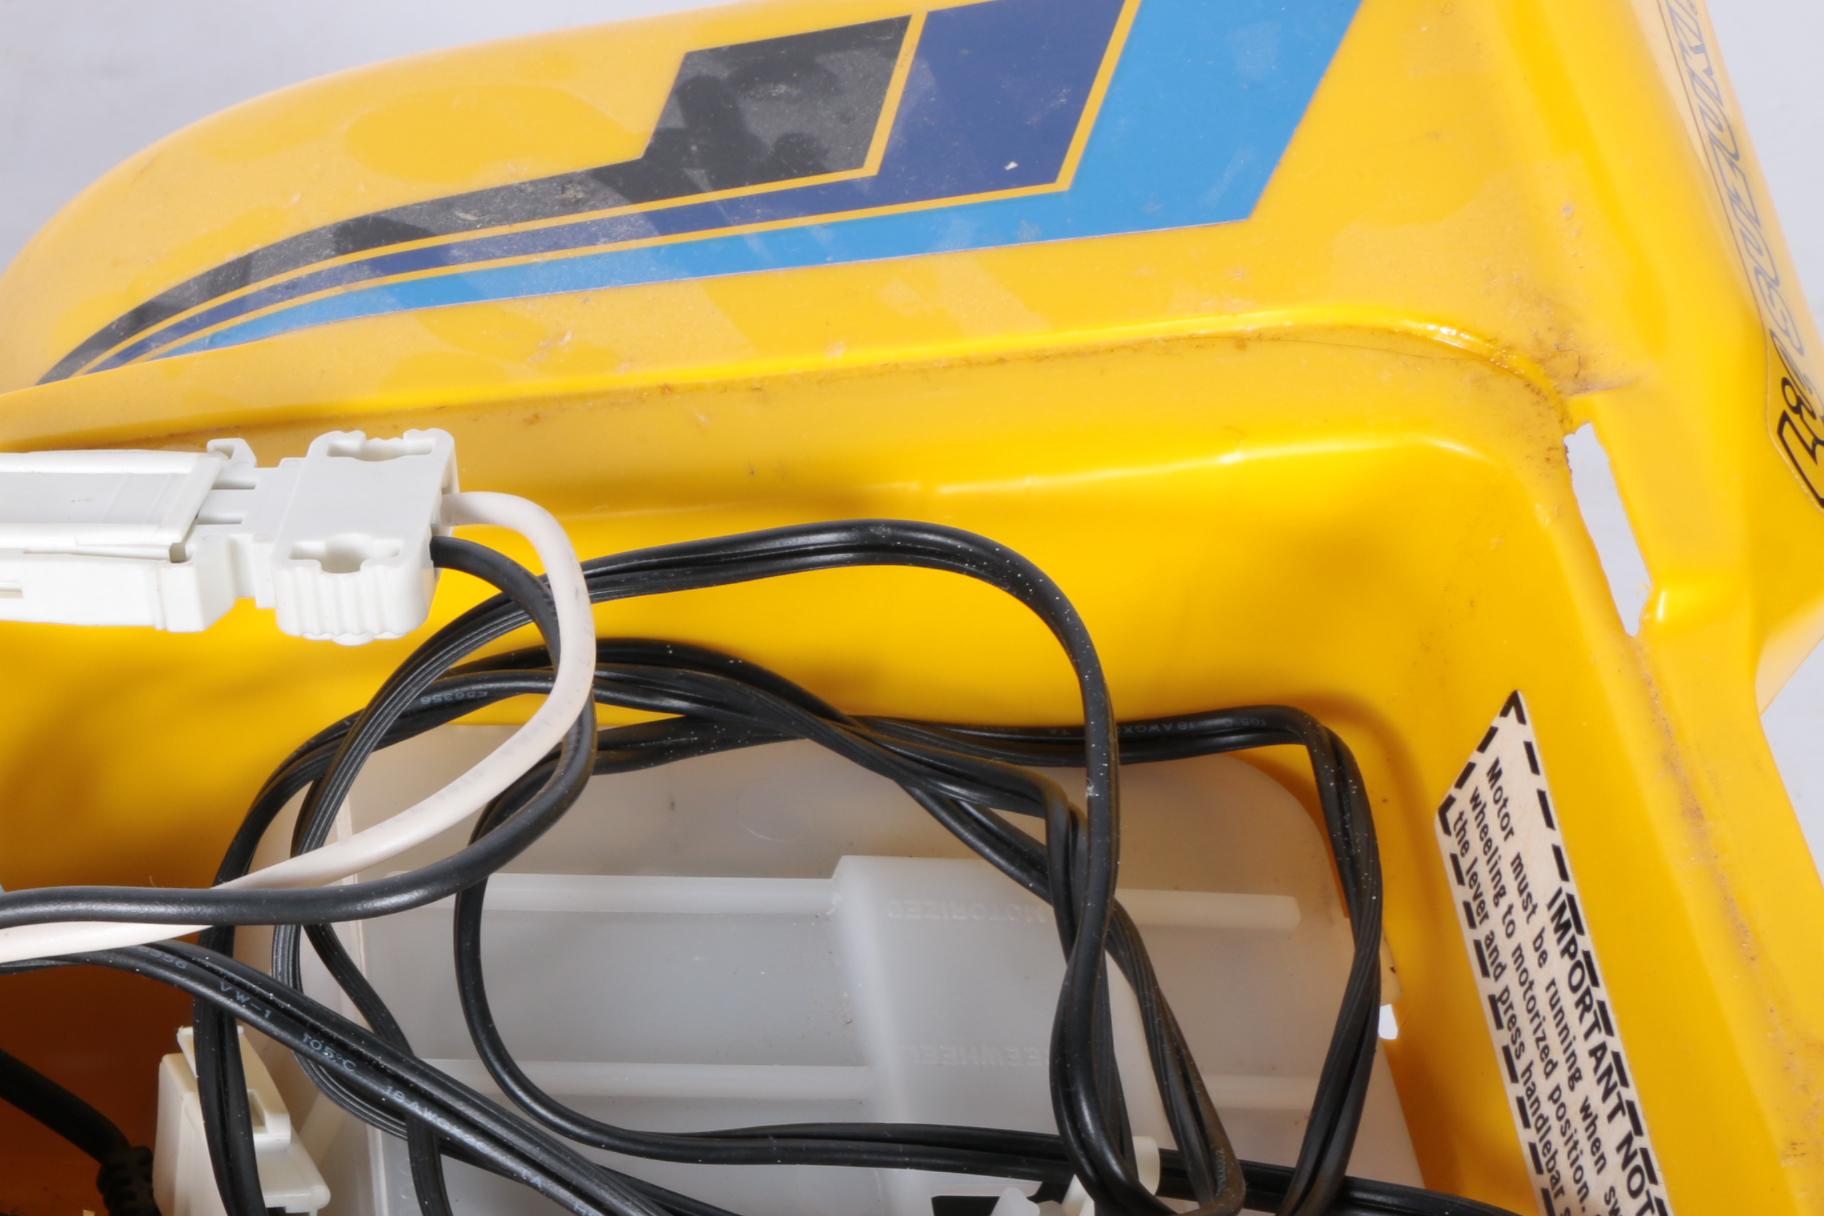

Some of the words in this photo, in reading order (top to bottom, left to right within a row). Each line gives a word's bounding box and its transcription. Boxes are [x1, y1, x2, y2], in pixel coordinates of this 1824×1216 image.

[1453, 810, 1471, 858] the
[1463, 856, 1491, 927] lever
[1483, 931, 1507, 983] and
[1495, 984, 1527, 1061] press
[1520, 1059, 1565, 1201] handlebar
[1469, 786, 1508, 908] wheeling
[1501, 902, 1517, 938] to
[1511, 945, 1558, 1082] motorized
[1549, 1082, 1588, 1213] position.
[1485, 757, 1515, 842] Motor
[1510, 851, 1539, 924] must
[1531, 920, 1549, 969] be
[1544, 976, 1582, 1091] running
[1578, 1095, 1607, 1175] when
[1546, 886, 1627, 1124] IMPORTANT
